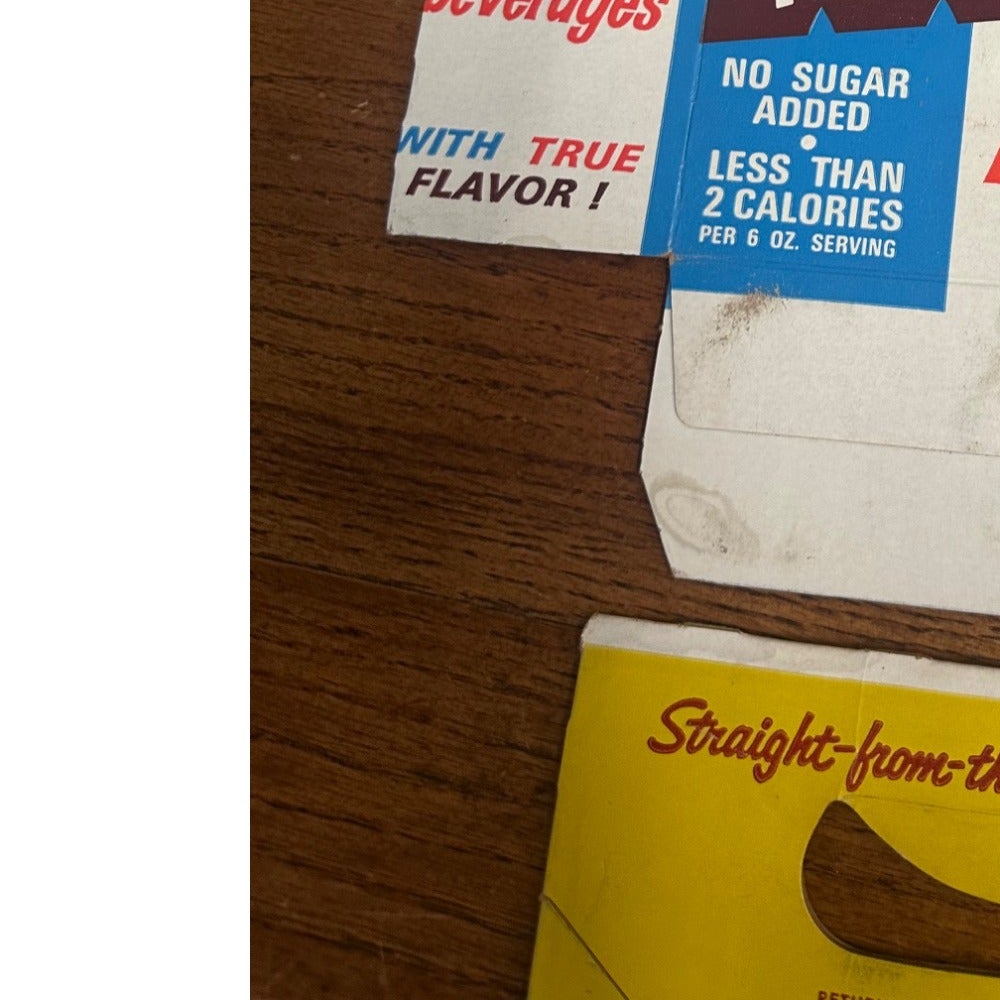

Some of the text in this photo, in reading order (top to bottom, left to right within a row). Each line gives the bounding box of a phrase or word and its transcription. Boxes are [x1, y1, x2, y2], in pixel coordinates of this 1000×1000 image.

[722, 56, 911, 99] NO SUGAR
[752, 94, 871, 132] ADDED
[529, 136, 646, 173] TRUE
[708, 149, 905, 194] LESS THAN
[702, 185, 904, 232] 2 CALORIES
[698, 224, 897, 259] PER 6 OZ. SERVING
